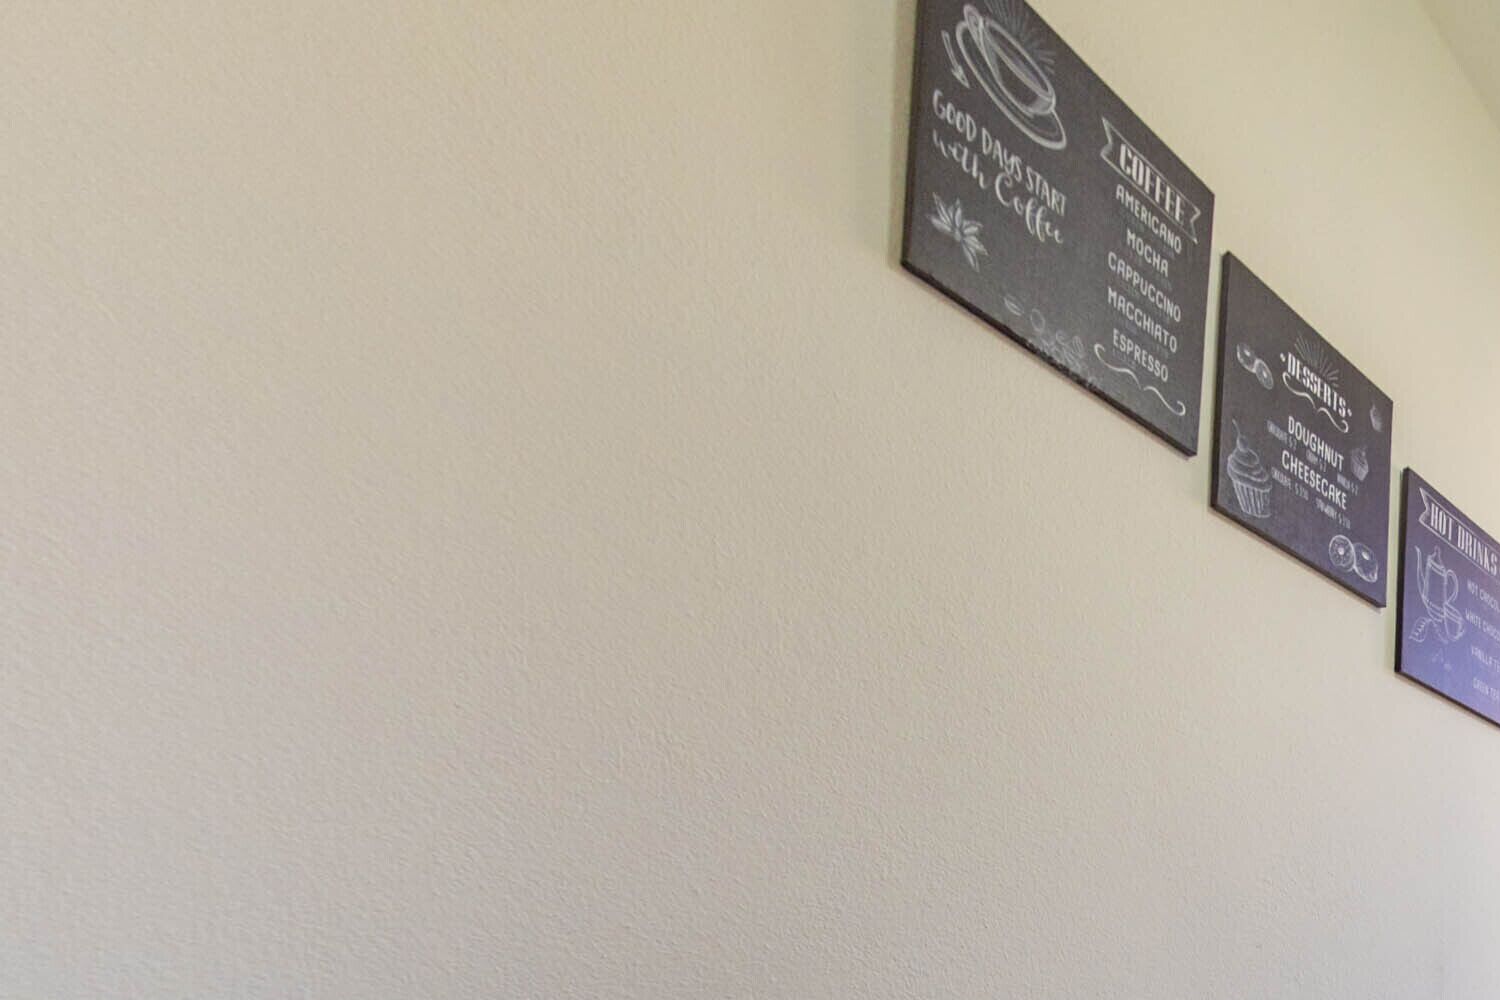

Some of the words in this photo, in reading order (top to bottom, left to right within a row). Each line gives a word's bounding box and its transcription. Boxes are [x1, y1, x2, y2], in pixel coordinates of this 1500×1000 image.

[932, 89, 977, 142] GOOD
[982, 127, 1022, 182] DAYS
[1026, 165, 1067, 216] START
[932, 128, 987, 189] with
[995, 172, 1064, 244] Coffee
[1119, 143, 1186, 226] COFFEE
[1116, 184, 1182, 254] AMERICANO
[1126, 228, 1169, 277] MOCHA
[1107, 251, 1181, 322] CAPPUCCINO
[1107, 286, 1178, 353] MACCHIATO
[1113, 327, 1169, 382] ESPRESSO
[1287, 352, 1347, 418] DESSERTS
[1288, 415, 1344, 472] DOUGHNUT
[1281, 449, 1347, 511] CHEESECAKE
[1431, 503, 1454, 541] HOT
[1457, 525, 1498, 577] DRINKS
